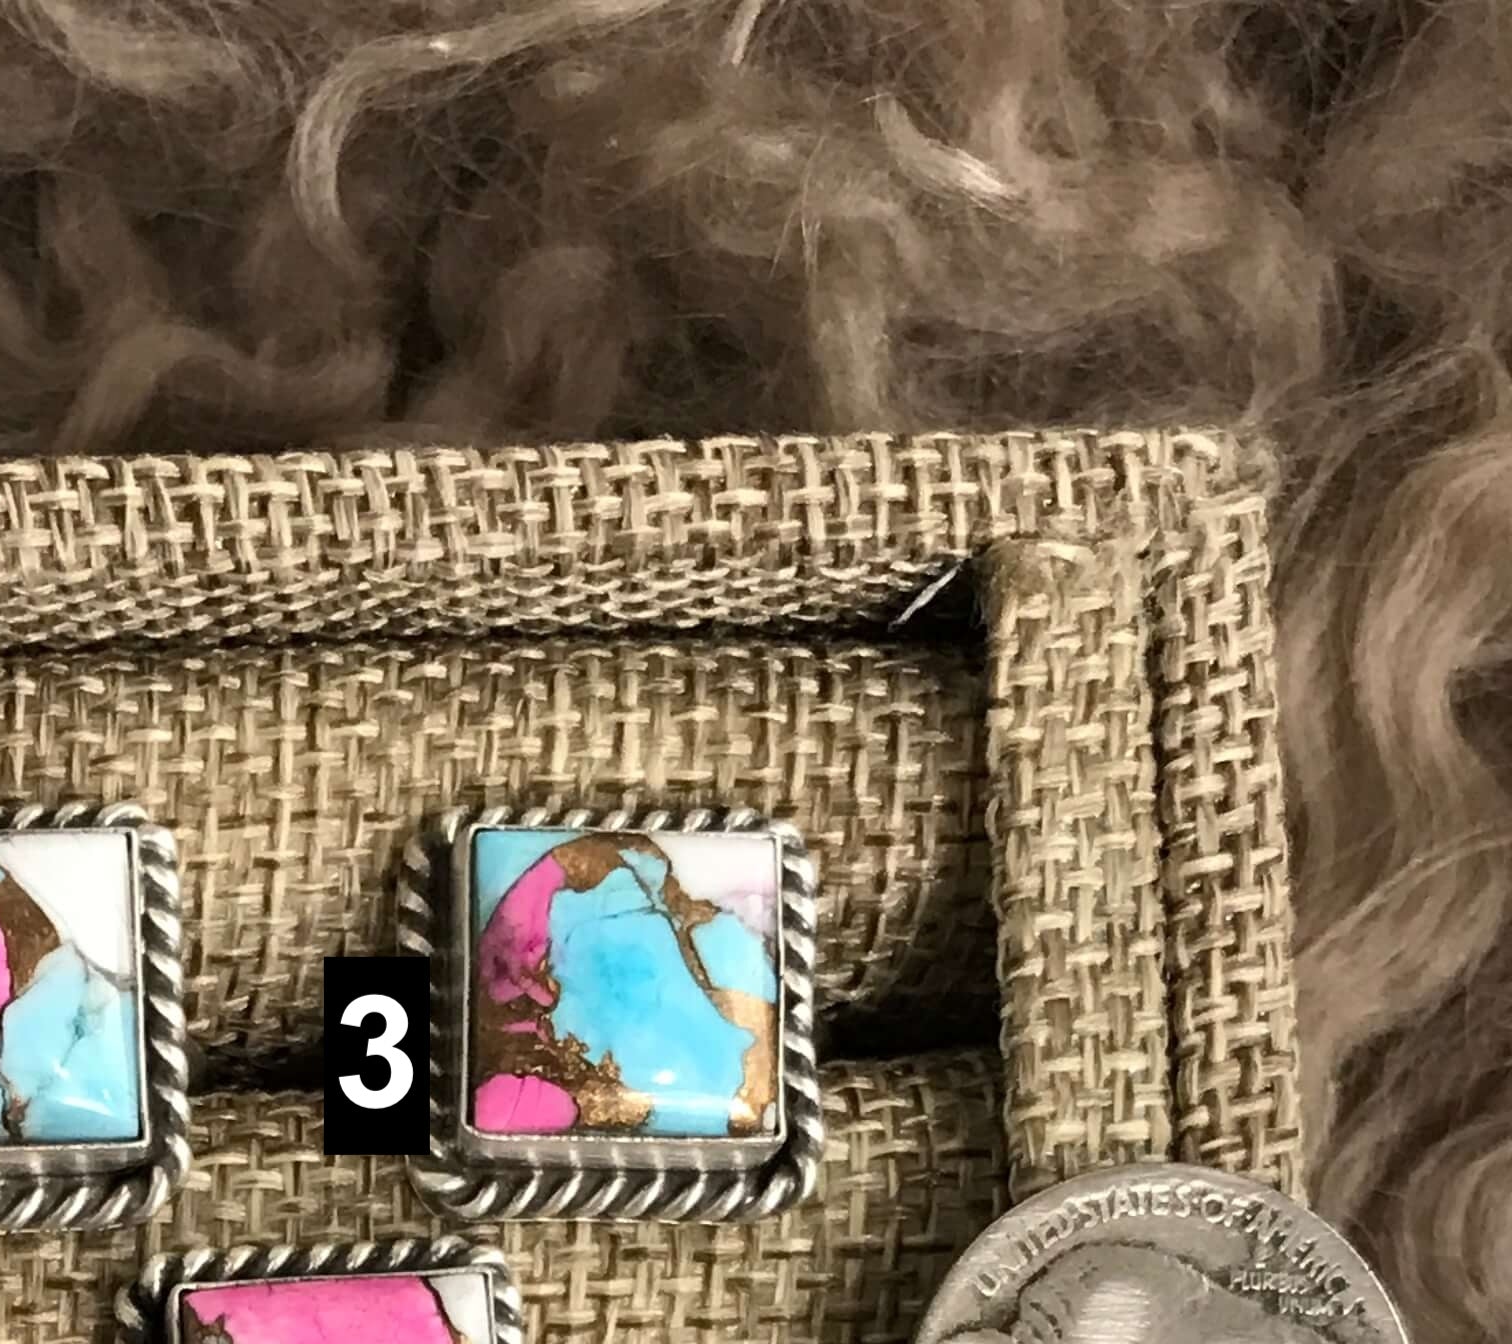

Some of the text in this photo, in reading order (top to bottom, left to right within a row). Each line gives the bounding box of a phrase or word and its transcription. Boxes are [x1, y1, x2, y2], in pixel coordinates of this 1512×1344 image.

[973, 1206, 1078, 1297] UNITED
[1075, 1178, 1192, 1229] STATES
[1200, 1192, 1251, 1228] OF
